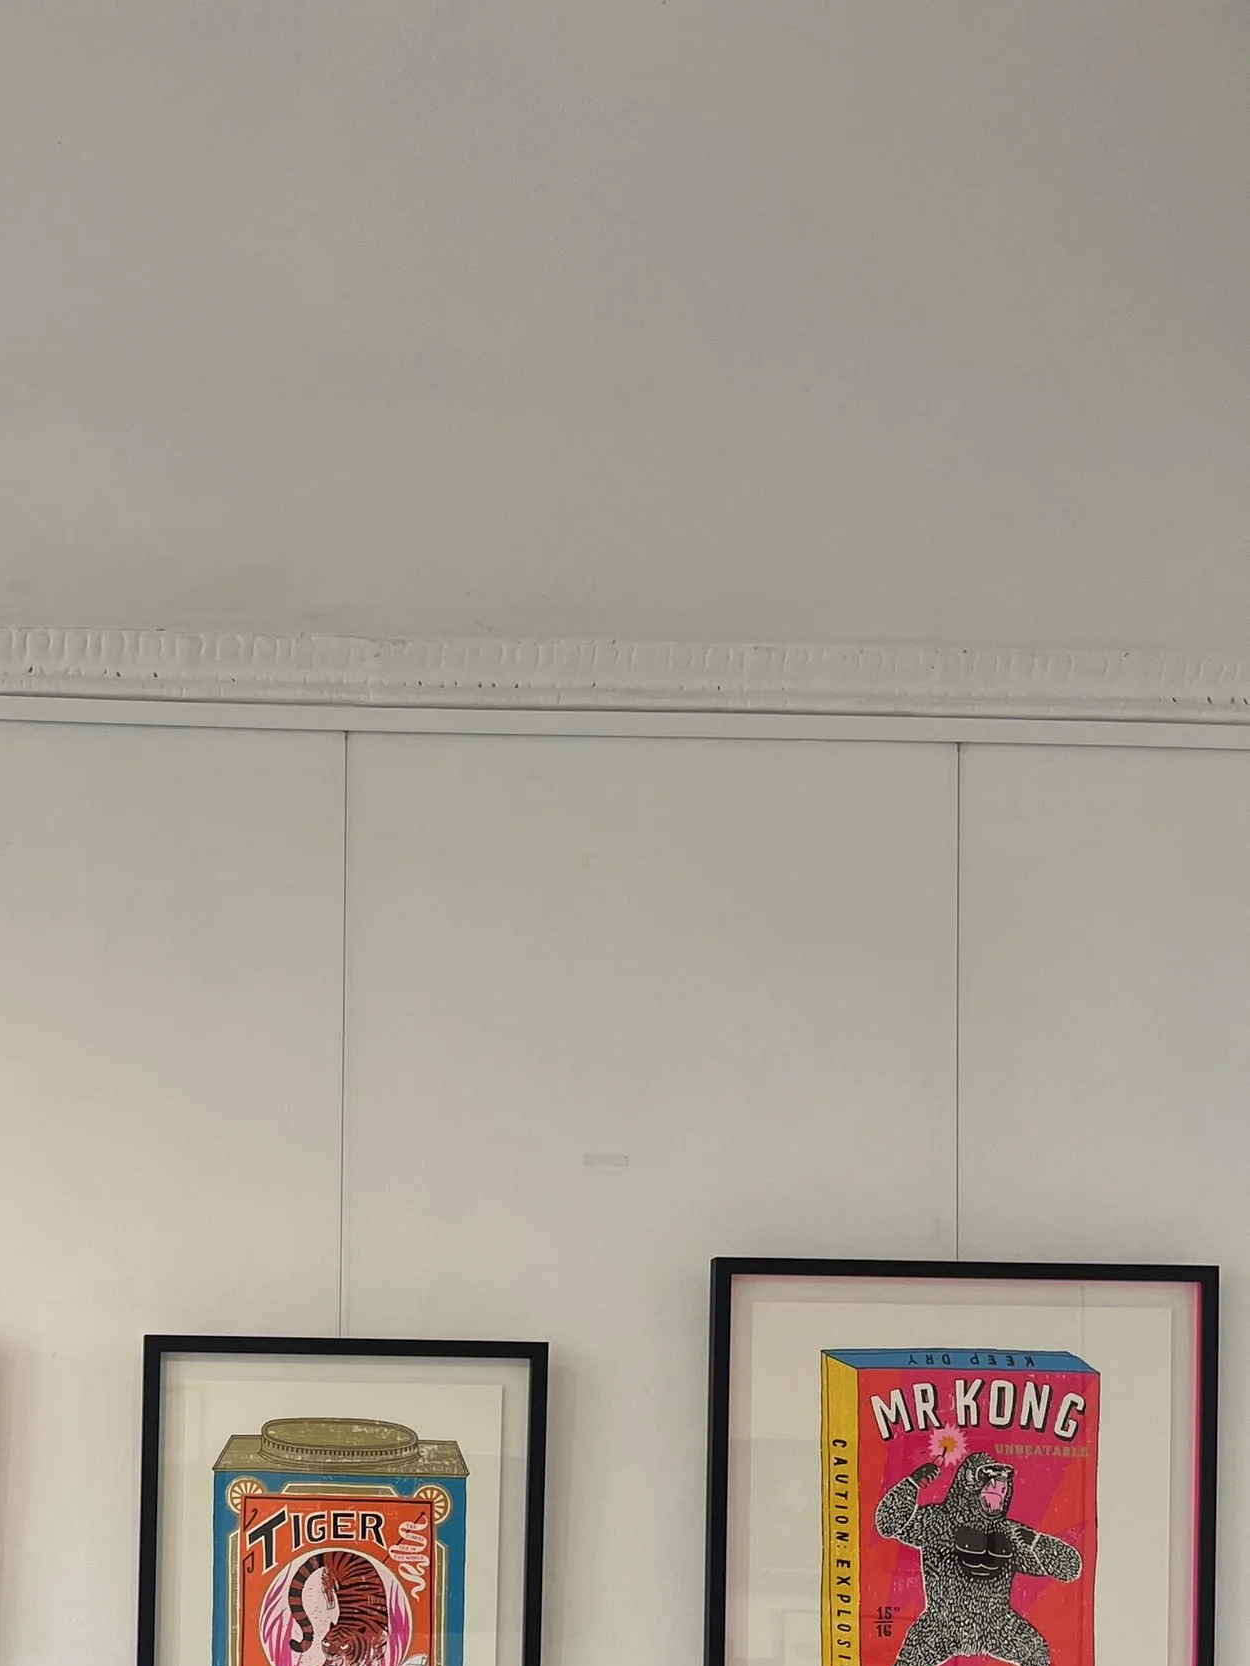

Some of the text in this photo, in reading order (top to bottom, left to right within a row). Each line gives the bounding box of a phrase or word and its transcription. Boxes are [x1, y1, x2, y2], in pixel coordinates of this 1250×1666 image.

[908, 1352, 1035, 1367] KEEP DRY
[870, 1378, 1086, 1441] MR KONG
[994, 1443, 1090, 1457] UNBEATABLE
[246, 1504, 388, 1576] TIGER
